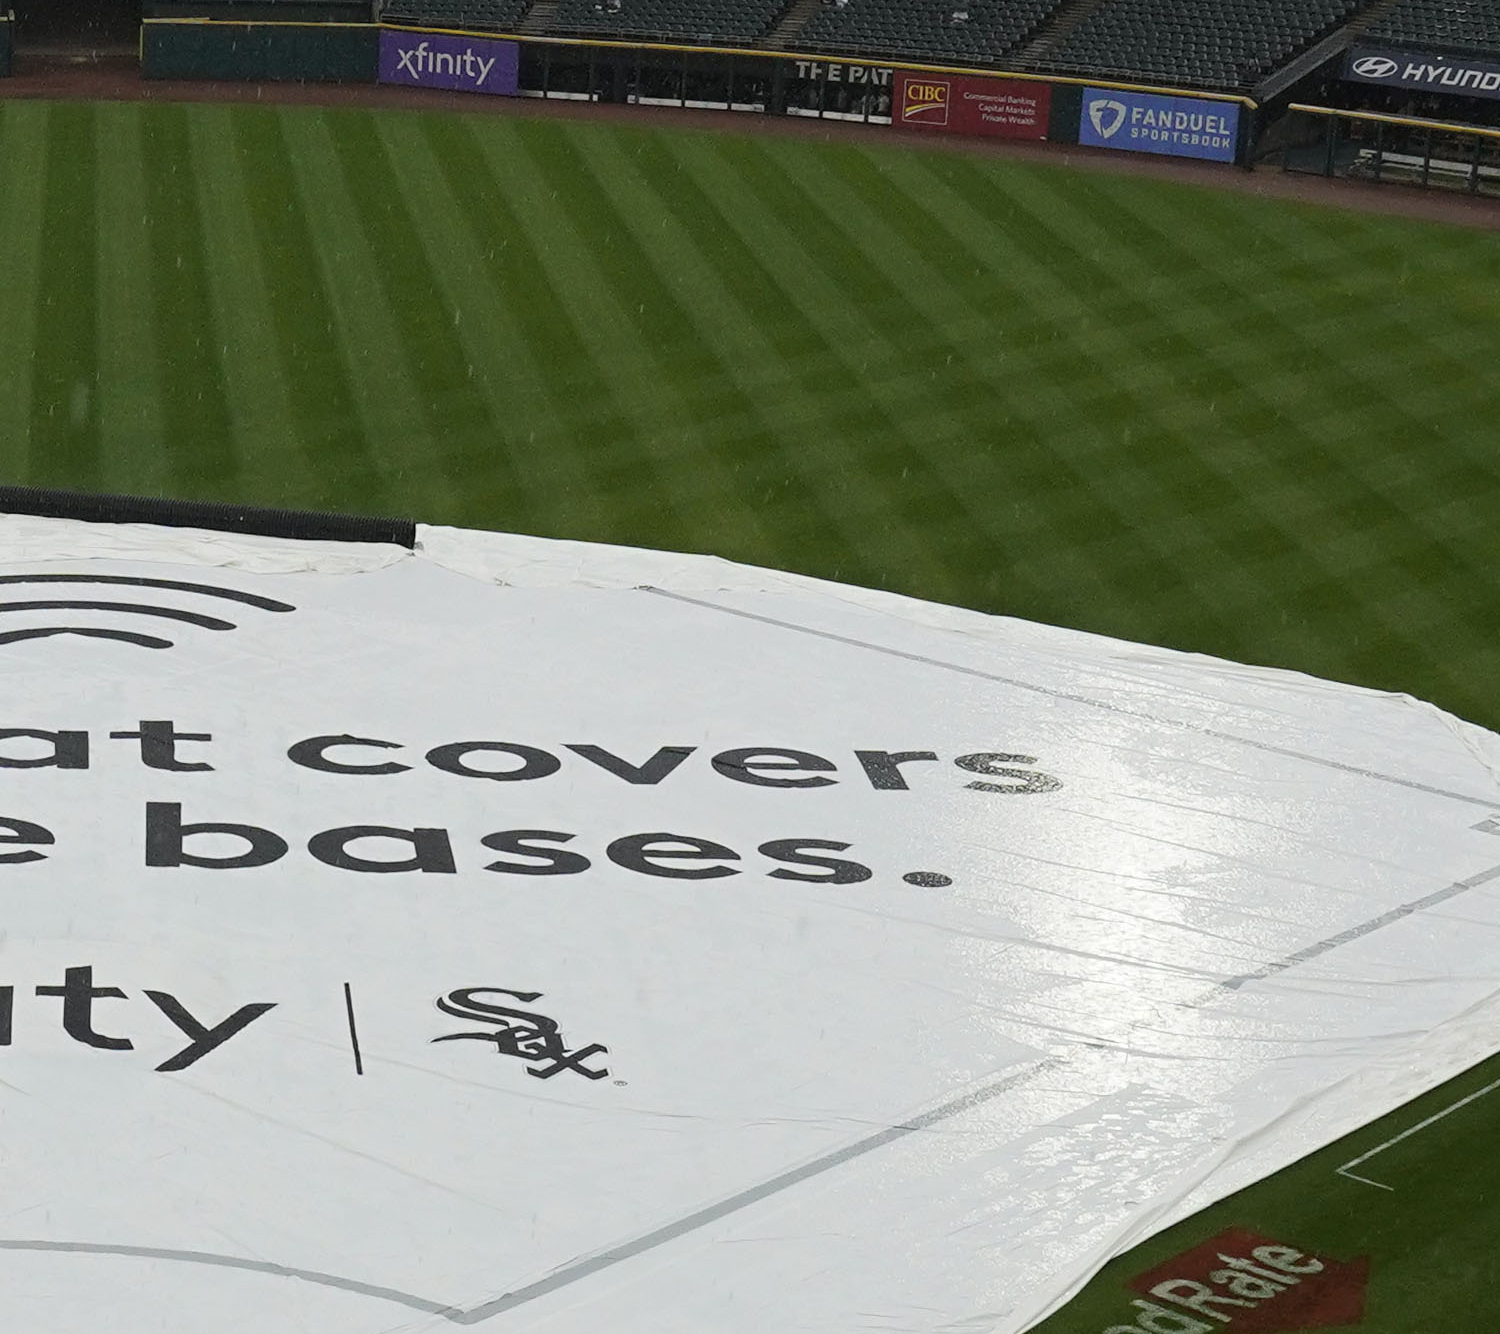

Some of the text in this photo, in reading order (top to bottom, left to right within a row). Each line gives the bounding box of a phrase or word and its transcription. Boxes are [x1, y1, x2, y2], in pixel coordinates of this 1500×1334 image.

[906, 84, 946, 103] CIBC
[963, 91, 1037, 108] Commercial Banking
[978, 103, 1036, 117] Capital Markets
[981, 113, 1036, 126] Private Wealth
[1130, 107, 1231, 136] FANDUEL
[1130, 127, 1231, 150] SPORTSBOOK
[290, 732, 1063, 797] covers
[145, 800, 955, 889] bases.
